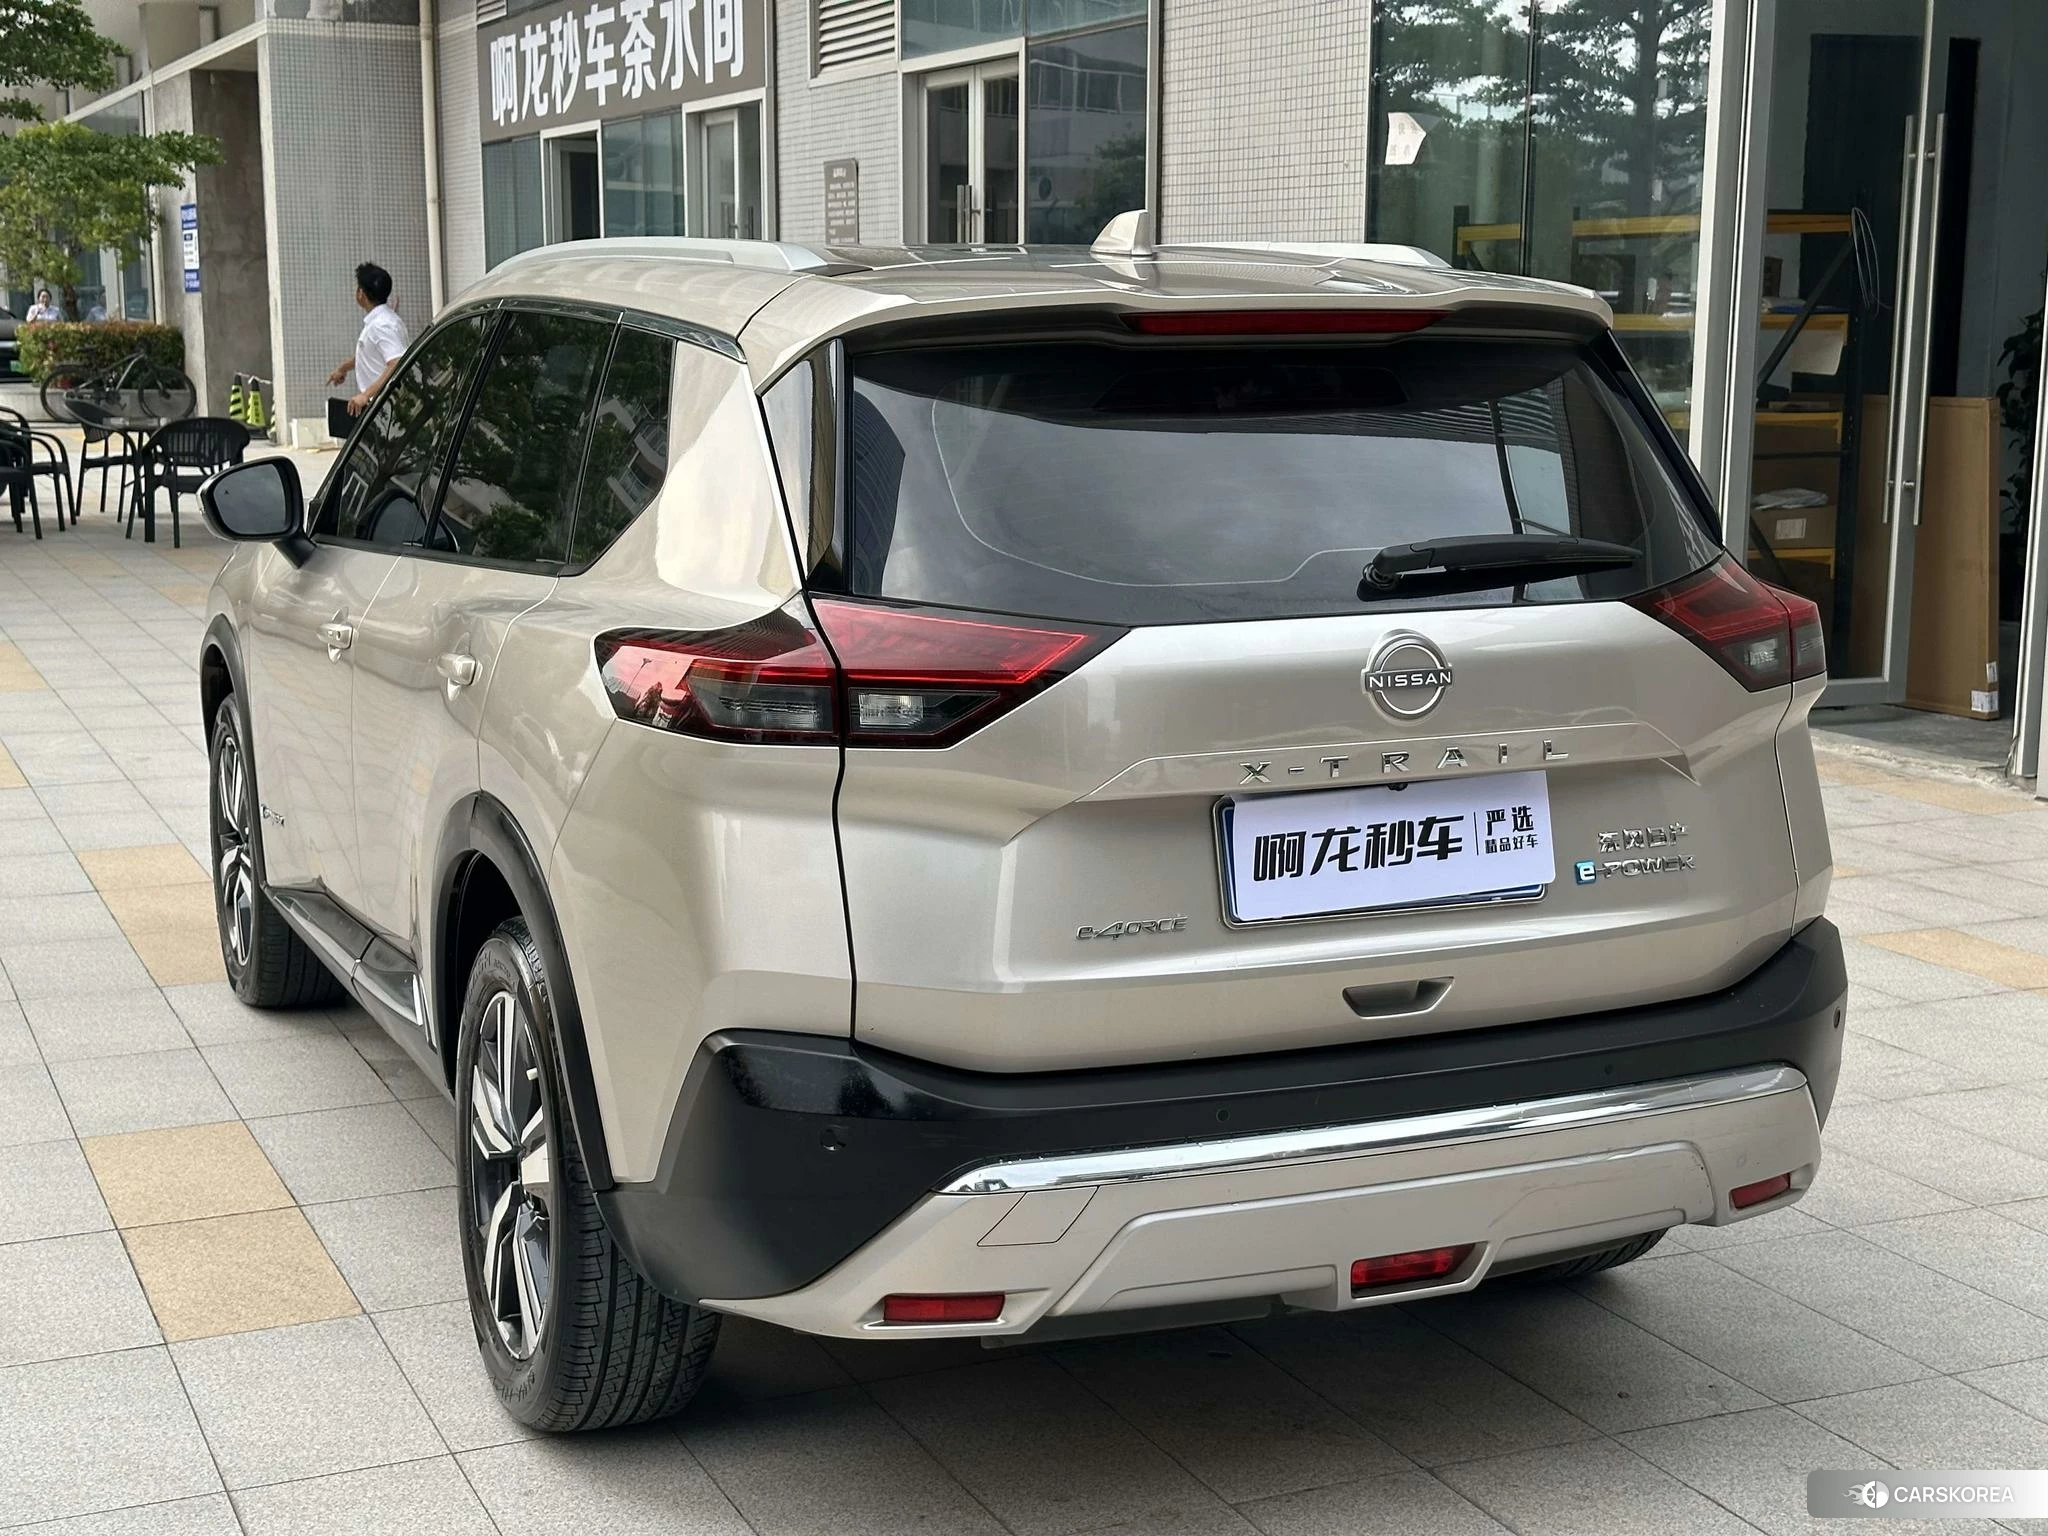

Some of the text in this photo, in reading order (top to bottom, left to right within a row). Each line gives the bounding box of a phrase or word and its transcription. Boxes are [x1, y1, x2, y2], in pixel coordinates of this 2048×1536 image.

[490, 0, 745, 127] 啊龙秒车茶水间
[1369, 671, 1451, 688] NISSAN
[1240, 740, 1569, 785] X-TRAIL
[1485, 805, 1534, 836] 严选
[1253, 815, 1464, 882] 啊龙秒车
[1484, 833, 1539, 854] 精品好车
[1598, 821, 1688, 853] 东风日产
[1575, 854, 1696, 885] e-POWER
